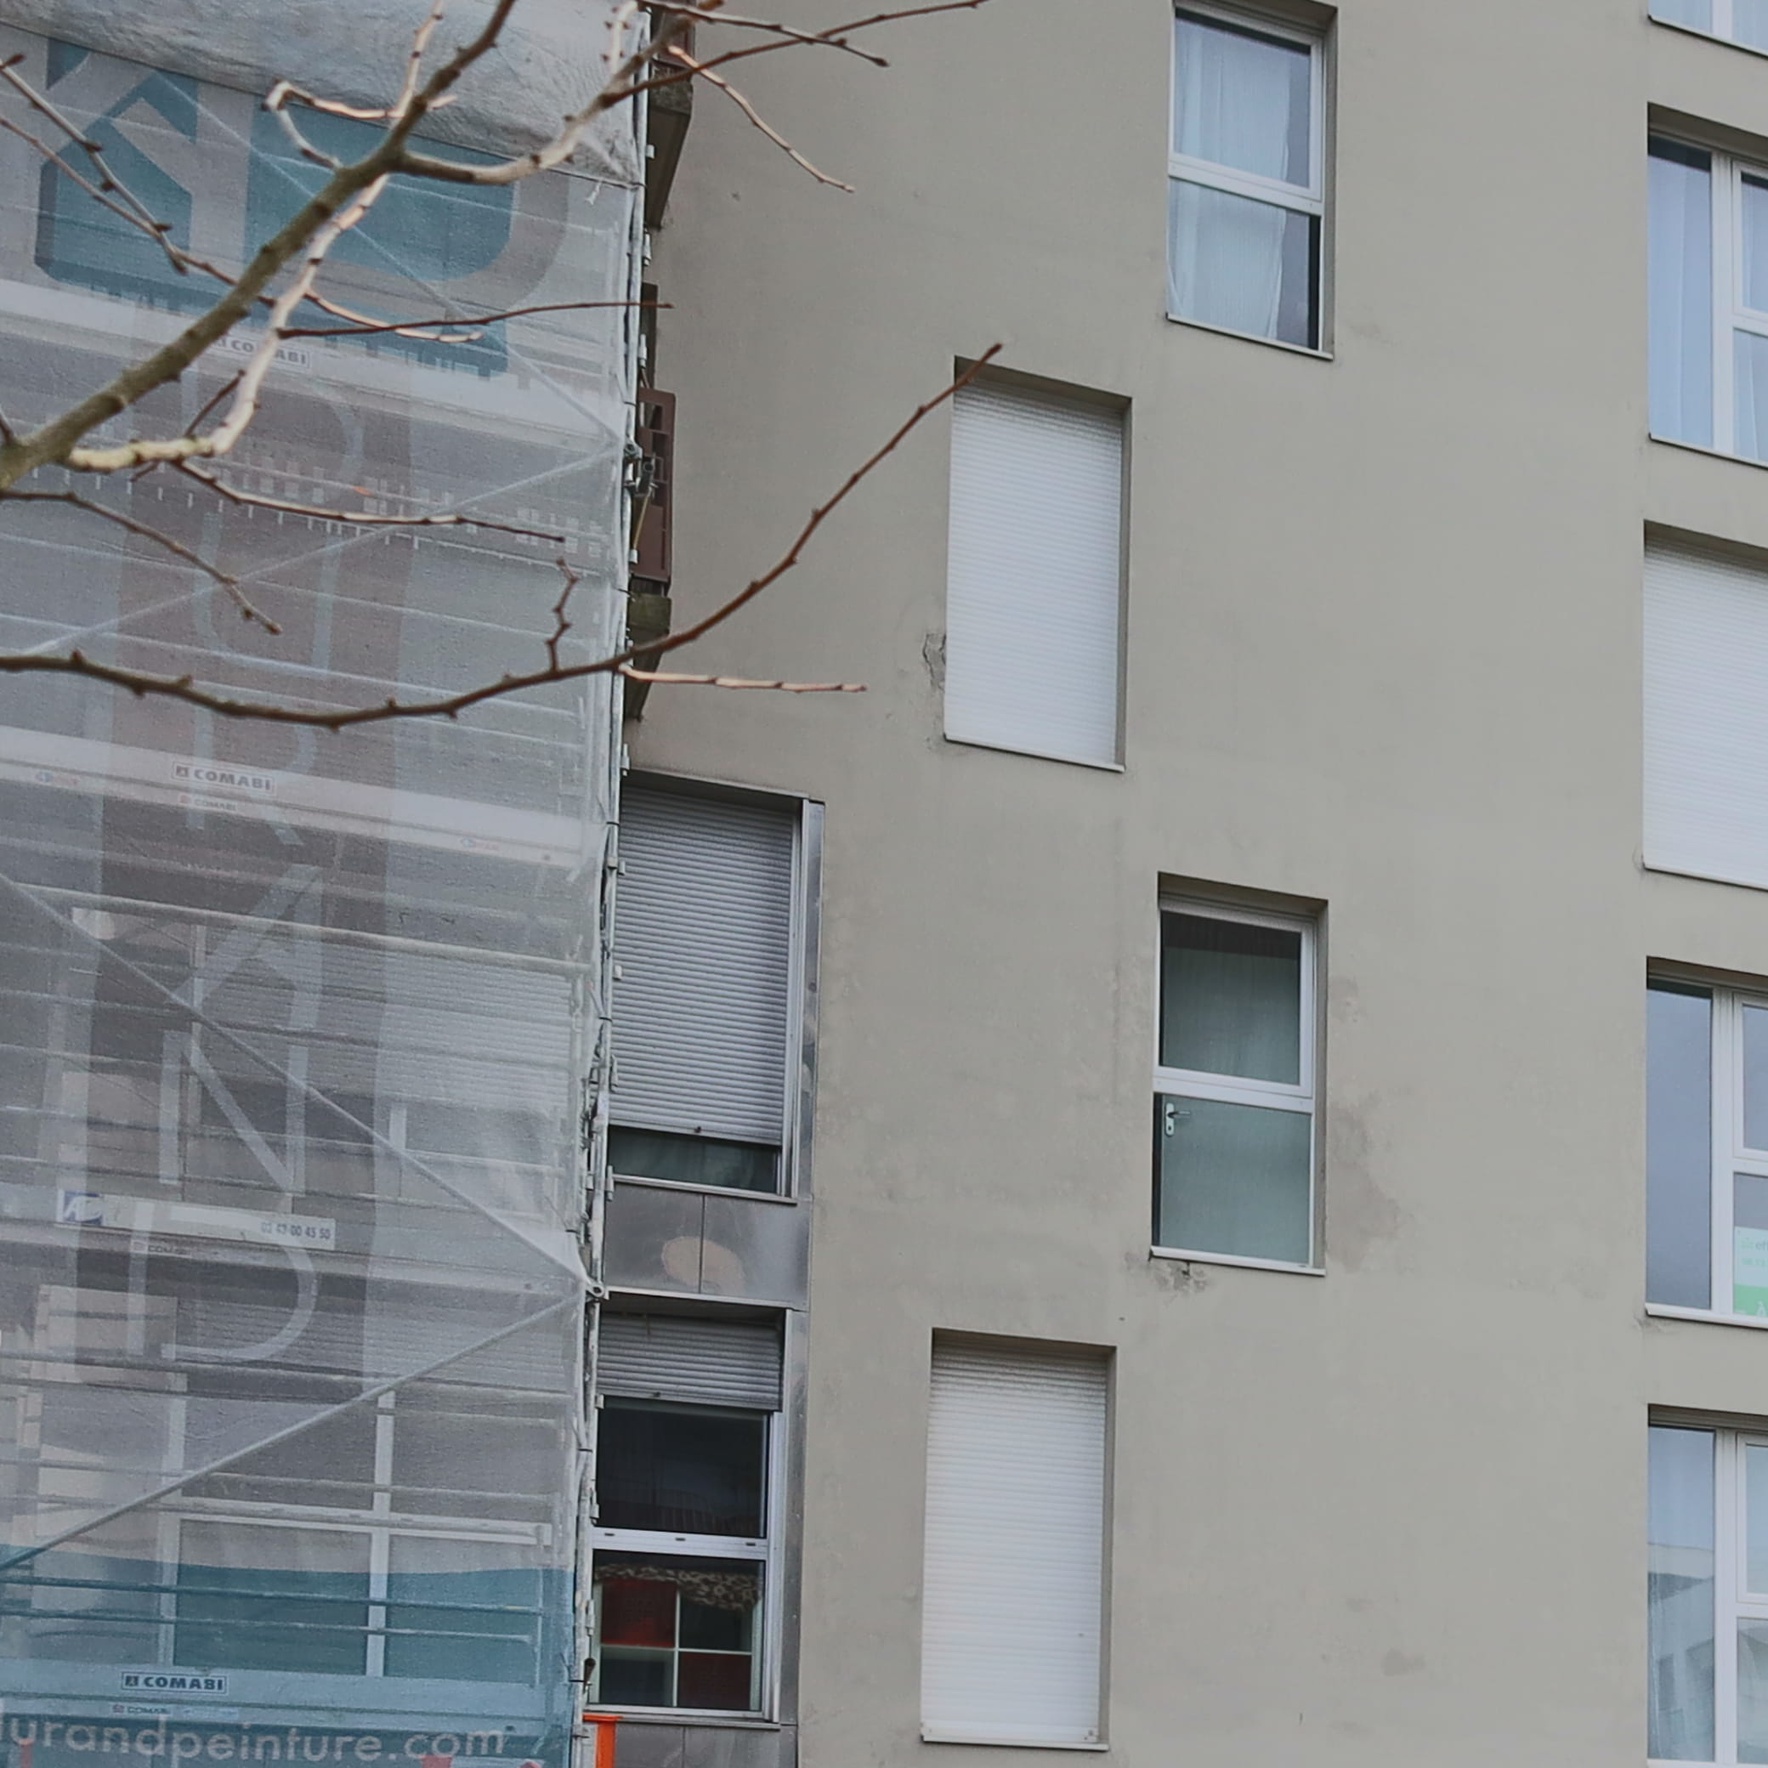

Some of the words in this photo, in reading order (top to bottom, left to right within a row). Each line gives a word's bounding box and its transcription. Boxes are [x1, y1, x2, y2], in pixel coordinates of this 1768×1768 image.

[231, 338, 306, 365] COABI
[194, 769, 271, 791] COMABI
[144, 1676, 223, 1691] COMABI
